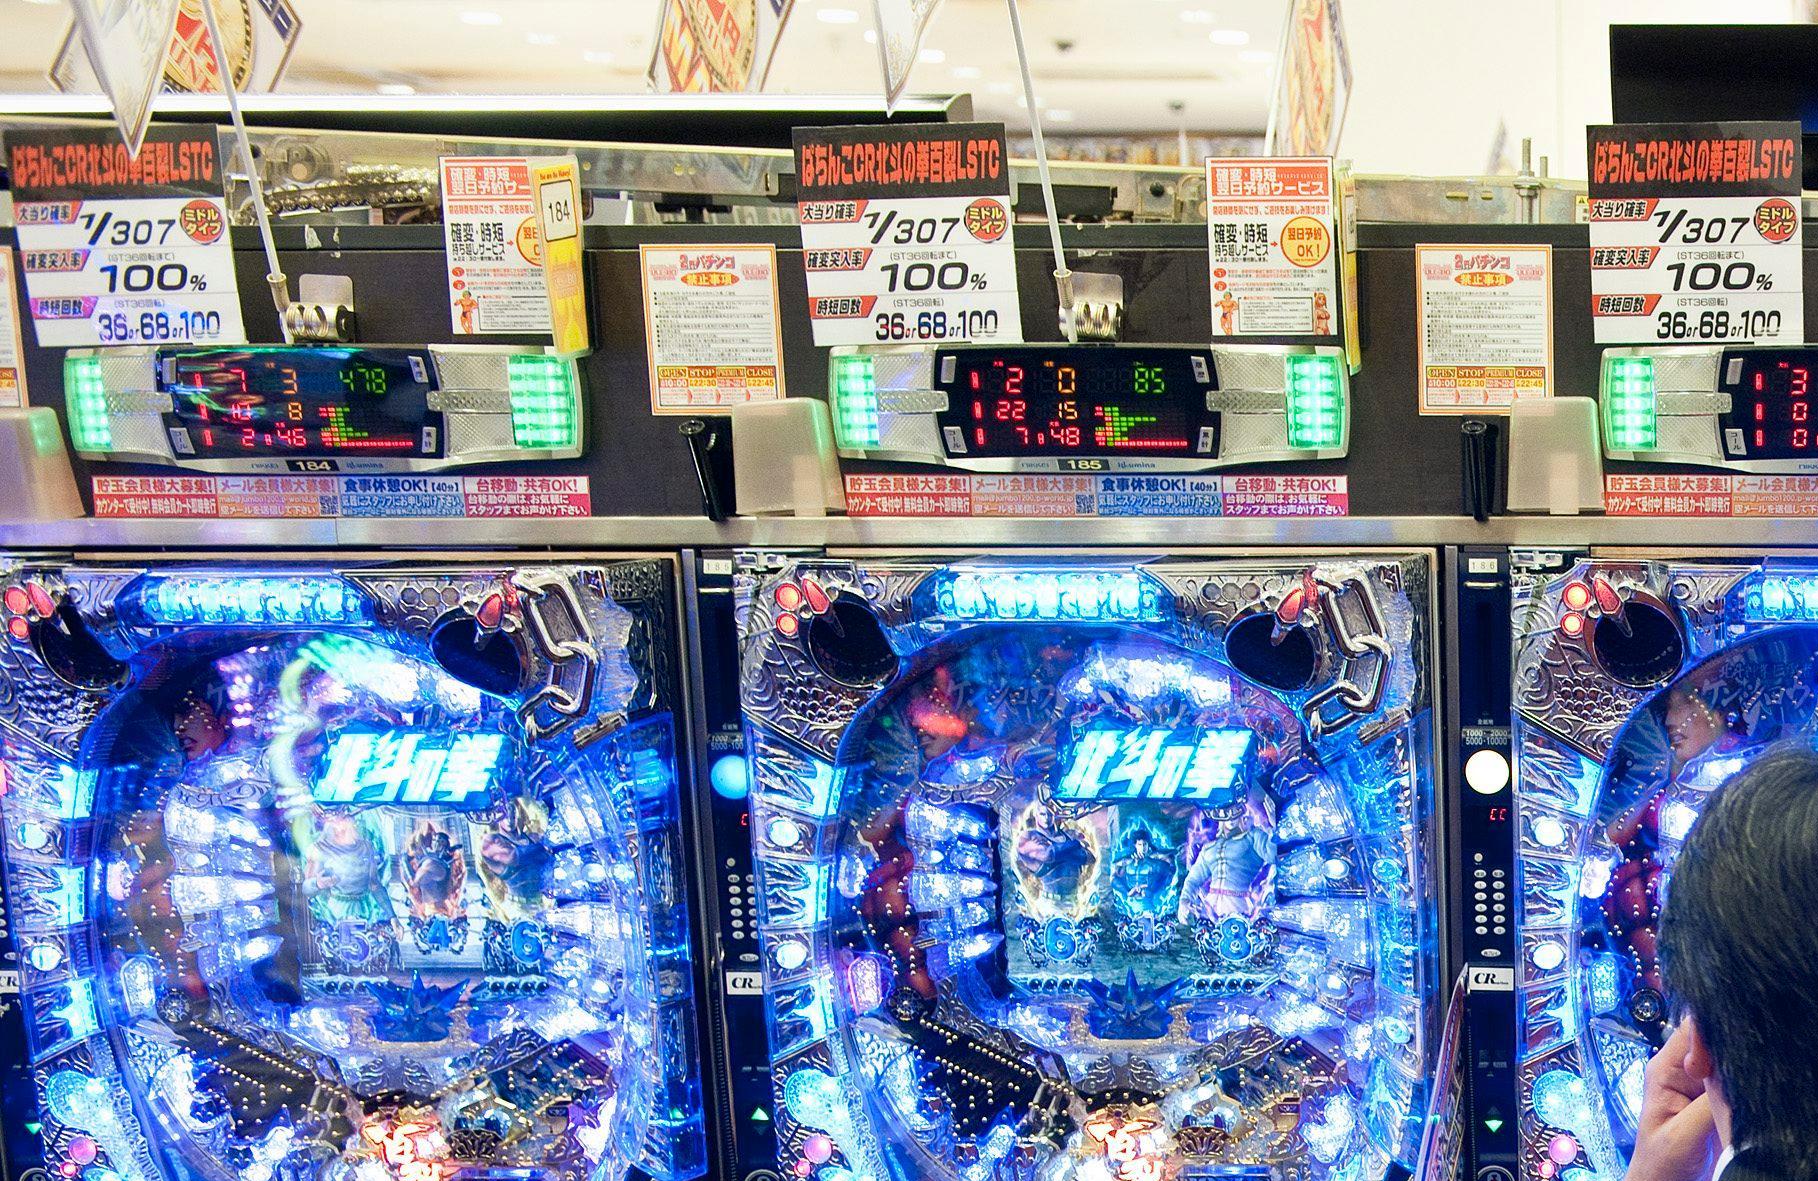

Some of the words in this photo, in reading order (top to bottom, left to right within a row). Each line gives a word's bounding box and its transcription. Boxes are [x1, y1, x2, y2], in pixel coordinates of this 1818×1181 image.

[1216, 181, 1325, 195] 翌日予約サービス
[549, 200, 570, 223] 184
[803, 203, 856, 220] 大当り確率
[969, 205, 1003, 220] ミドル
[1592, 202, 1646, 218] 大当り確率
[1760, 206, 1793, 220] ミドル
[1288, 228, 1322, 241] 翌日予約
[1297, 245, 1320, 258] OK!
[1592, 250, 1649, 266] 確変突入率
[807, 251, 862, 268] 確変突入率
[881, 262, 987, 292] 100%
[1666, 262, 1773, 291] 100%
[817, 299, 862, 315] 時短回数
[1599, 297, 1644, 313] 時短回数
[689, 369, 715, 377] STOP
[748, 369, 774, 377] CLOSE
[1006, 368, 1023, 393] 2
[1058, 368, 1076, 393] 0
[1135, 368, 1165, 393] 85
[1458, 369, 1484, 377] STOP
[1516, 369, 1542, 377] CLOSE
[996, 401, 1026, 420] 22
[1058, 401, 1078, 419] 15
[296, 461, 331, 471] 184
[1068, 459, 1102, 470] 185
[1611, 478, 1728, 491] 貯玉会員様大募集!
[706, 560, 731, 572] 185
[1471, 561, 1496, 570] 186
[312, 732, 504, 802] 北斗の拳
[1061, 729, 1255, 799] 北斗の拳
[731, 976, 753, 991] CR
[1474, 973, 1496, 985] CR
